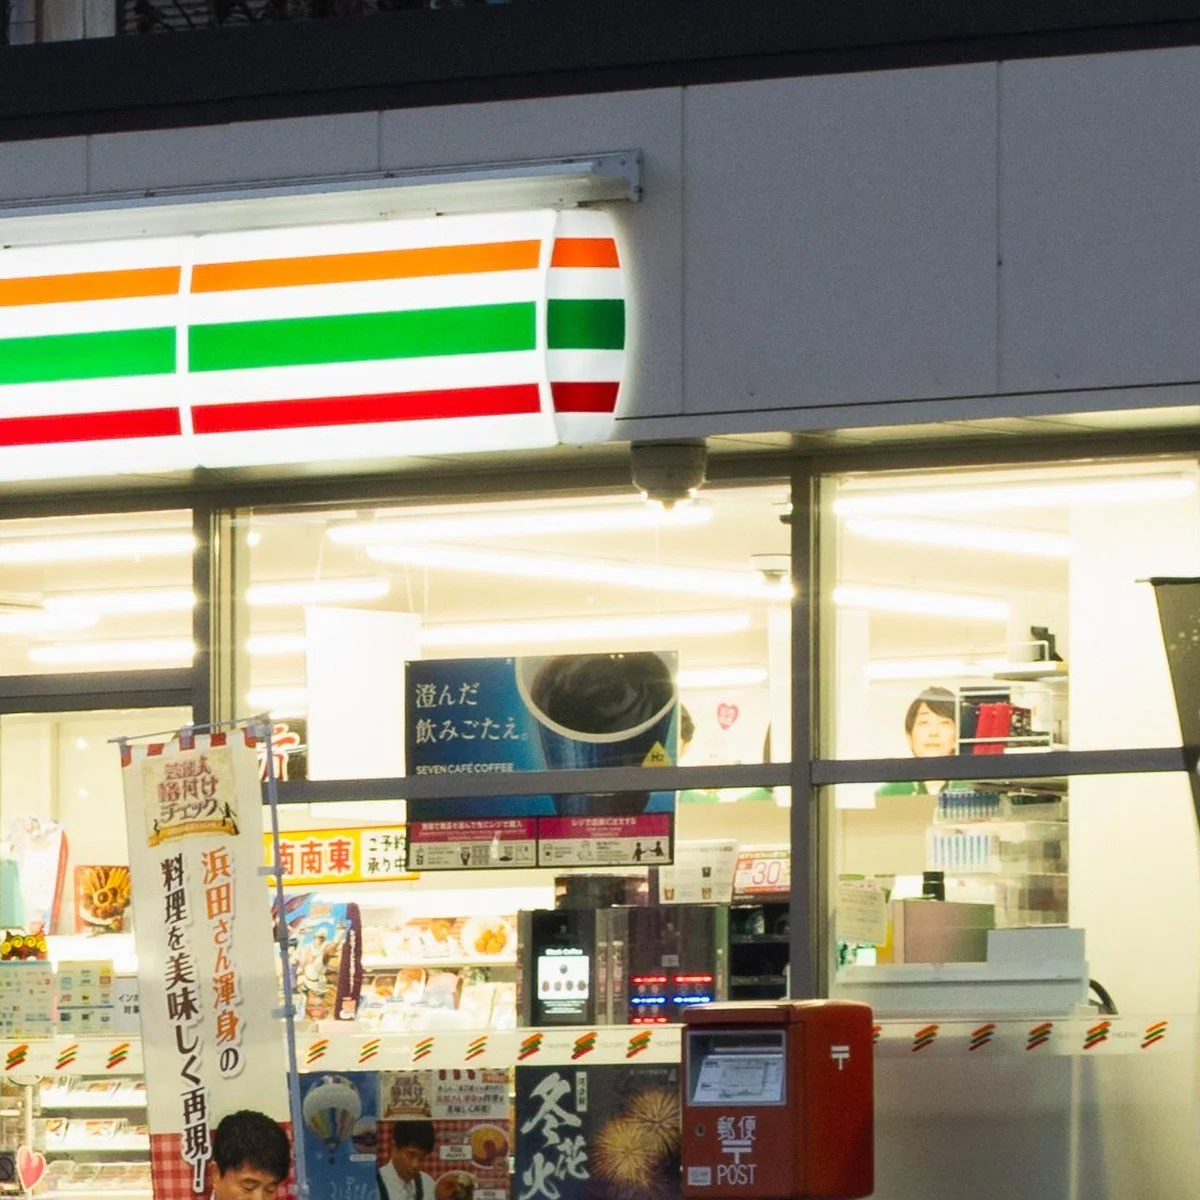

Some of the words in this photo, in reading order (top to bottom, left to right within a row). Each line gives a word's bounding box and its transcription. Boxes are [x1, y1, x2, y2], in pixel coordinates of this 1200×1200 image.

[415, 682, 480, 708] 澄んだ
[415, 716, 529, 744] 飲みごたえ。
[416, 763, 448, 775] SEVEN
[448, 762, 474, 774] CAFÉ
[474, 762, 514, 773] COFFEE
[201, 846, 240, 1072] 浜田さん渾身の
[717, 1115, 757, 1140] 郵便
[717, 1164, 757, 1186] POST
